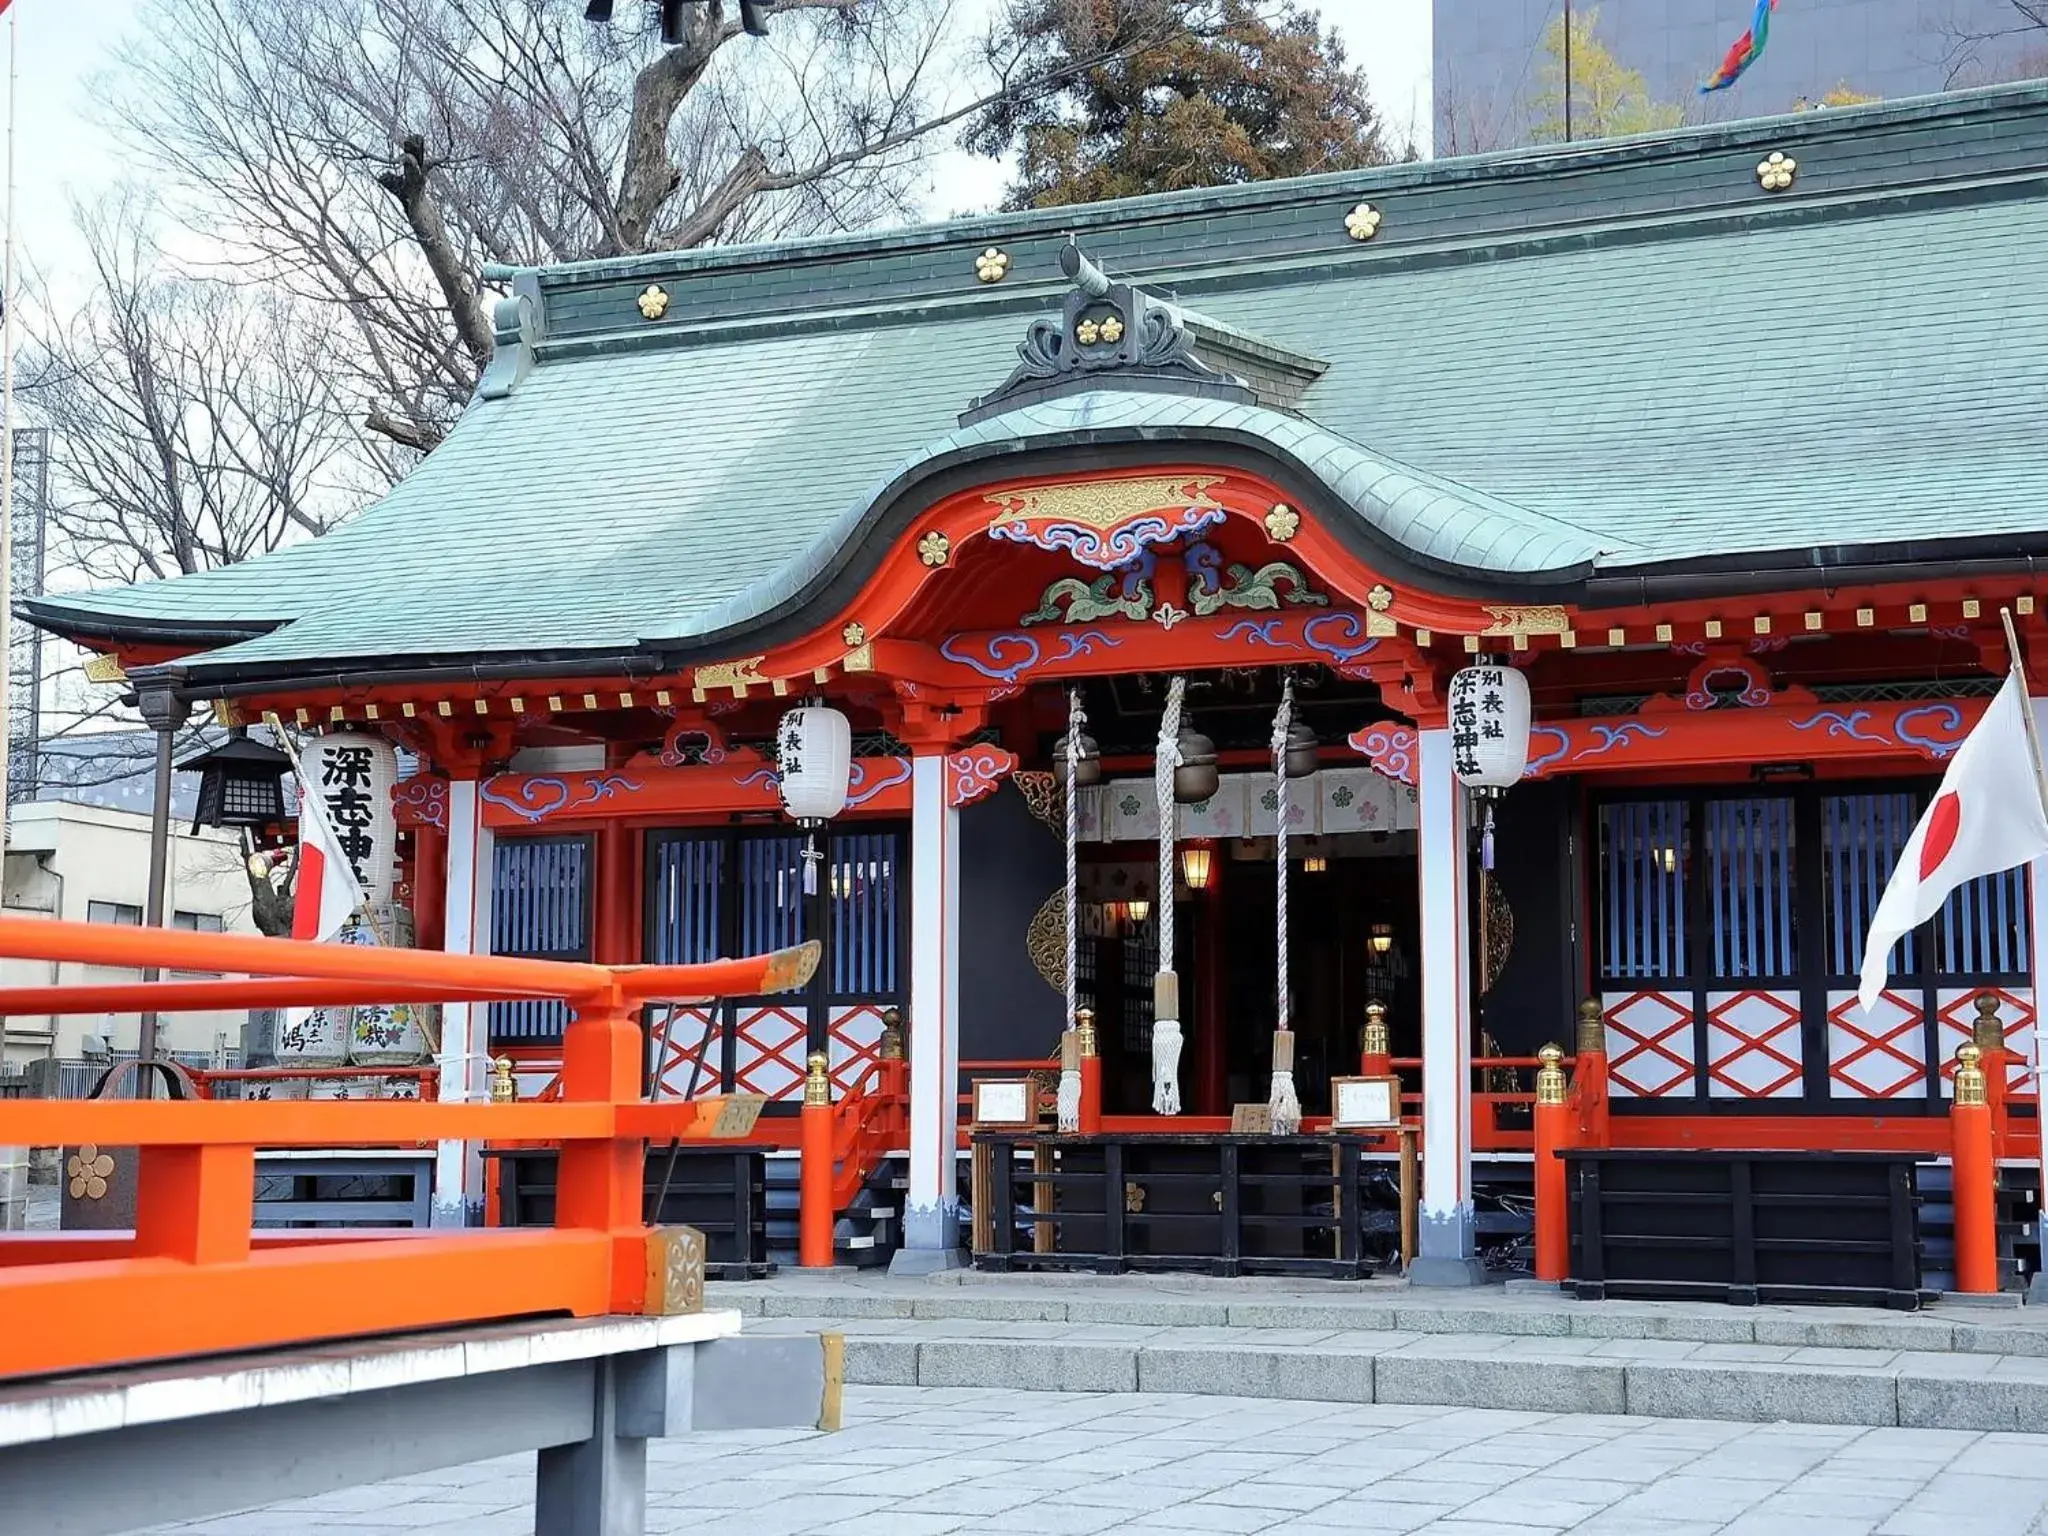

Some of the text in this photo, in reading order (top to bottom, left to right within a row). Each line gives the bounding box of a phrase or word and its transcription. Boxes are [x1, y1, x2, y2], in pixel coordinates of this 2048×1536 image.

[1452, 669, 1483, 777] 深志神社
[1481, 670, 1505, 739] 別表社
[785, 712, 805, 774] 別表社
